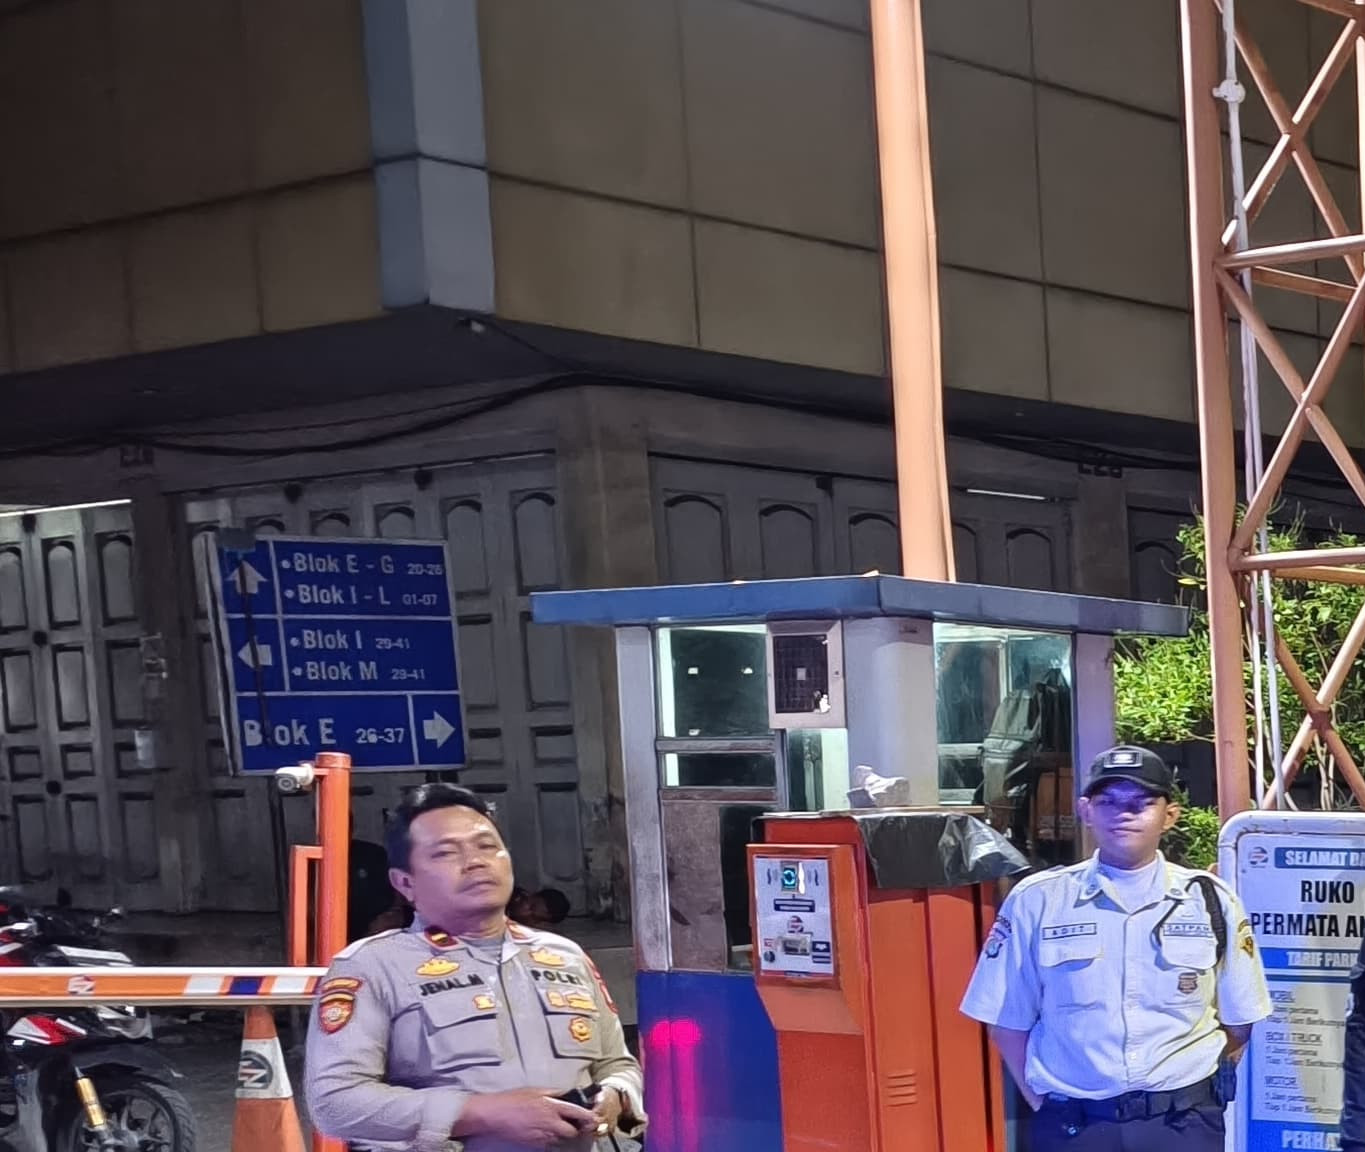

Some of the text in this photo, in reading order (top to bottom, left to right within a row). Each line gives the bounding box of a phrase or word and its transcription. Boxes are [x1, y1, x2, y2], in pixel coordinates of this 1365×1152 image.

[293, 552, 340, 573] Blok
[346, 554, 360, 573] E
[380, 555, 394, 574] G
[297, 584, 344, 604] Blok
[350, 586, 358, 604] I
[378, 586, 391, 605] L
[303, 630, 348, 649] Blok
[355, 630, 362, 649] I
[306, 661, 353, 681] Blok
[359, 661, 378, 681] M
[318, 718, 337, 745] E
[1285, 850, 1348, 866] SELAMAT
[1300, 879, 1355, 904] RUKO
[1250, 912, 1340, 938] PERMATA
[1286, 951, 1323, 967] TARIF
[530, 969, 584, 986] POLRI
